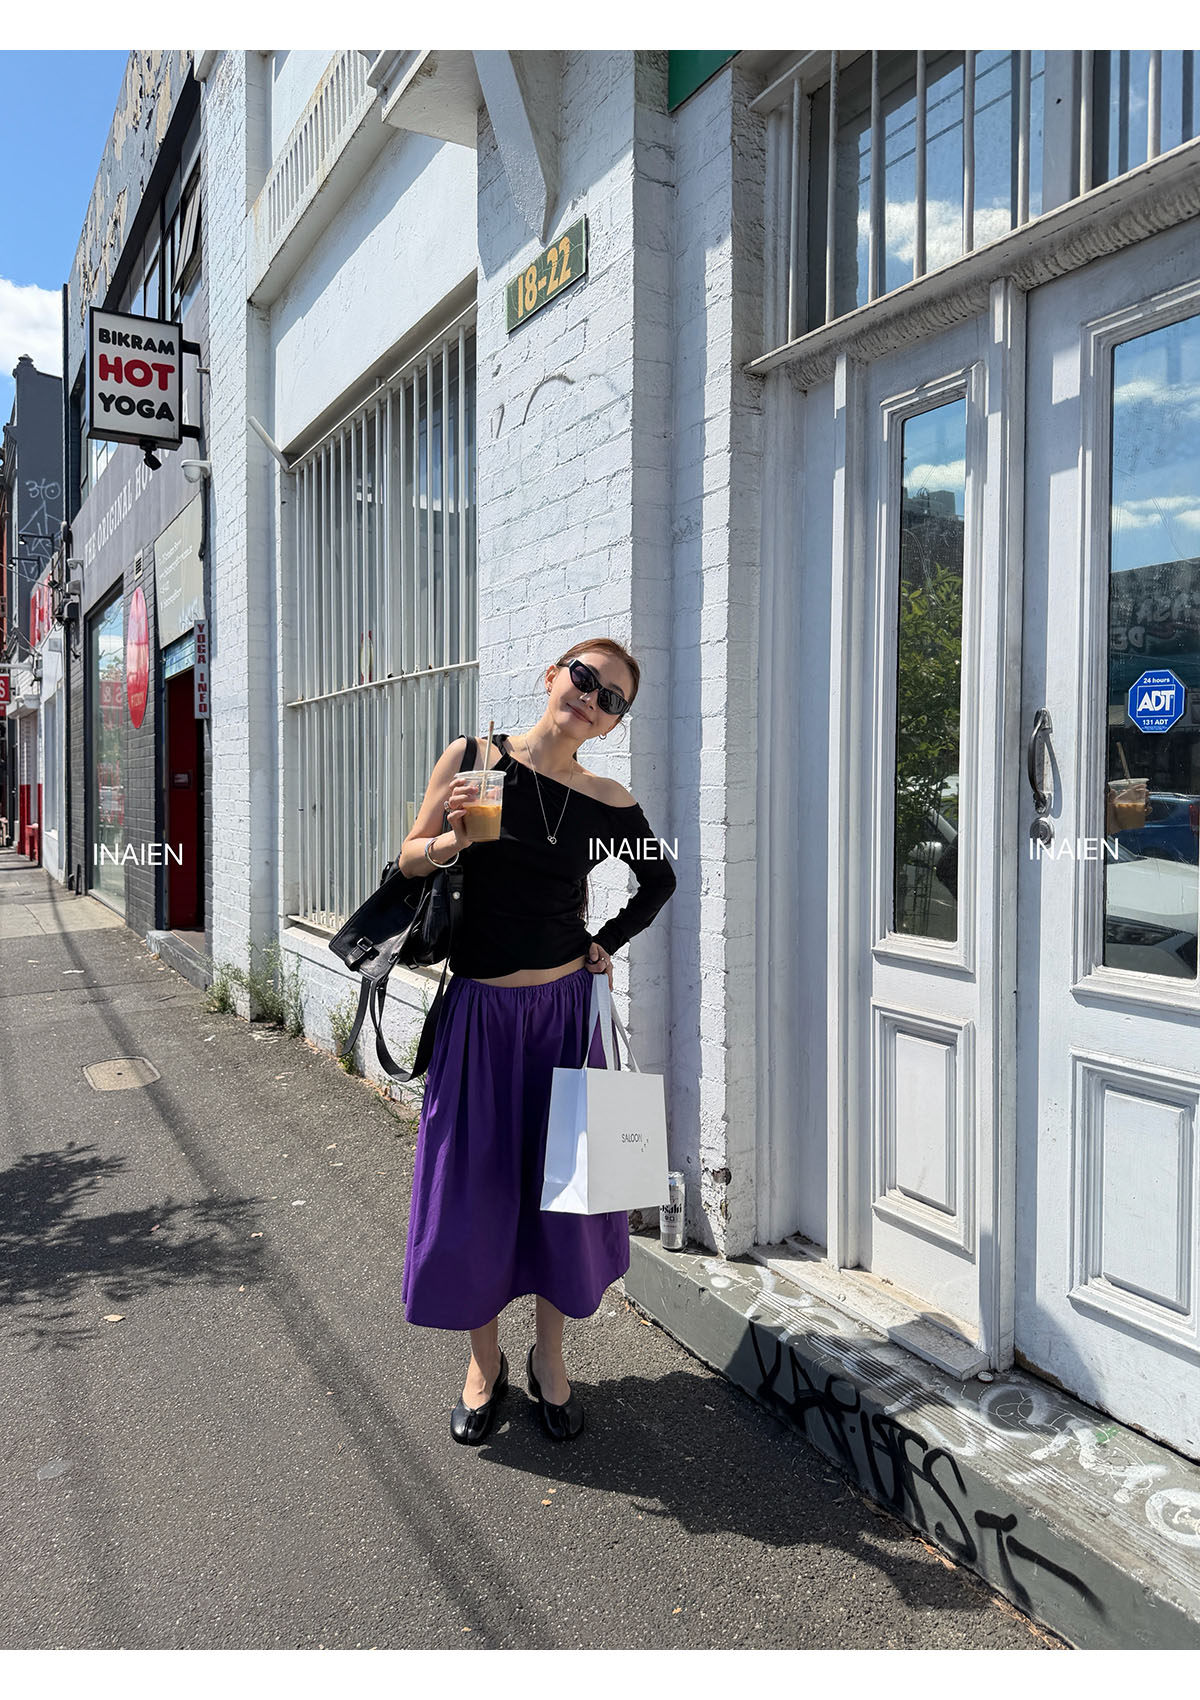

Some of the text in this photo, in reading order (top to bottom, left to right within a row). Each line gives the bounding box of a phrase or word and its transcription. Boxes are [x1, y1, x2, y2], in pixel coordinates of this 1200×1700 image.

[517, 236, 572, 318] 18-22
[98, 327, 175, 356] BIKRAM
[98, 353, 175, 391] HOT
[98, 392, 175, 422] YOGA
[97, 478, 132, 552] ORIGINAL
[197, 623, 208, 713] YOGA INFO
[1136, 689, 1176, 712] ADT
[1154, 718, 1169, 726] ADT
